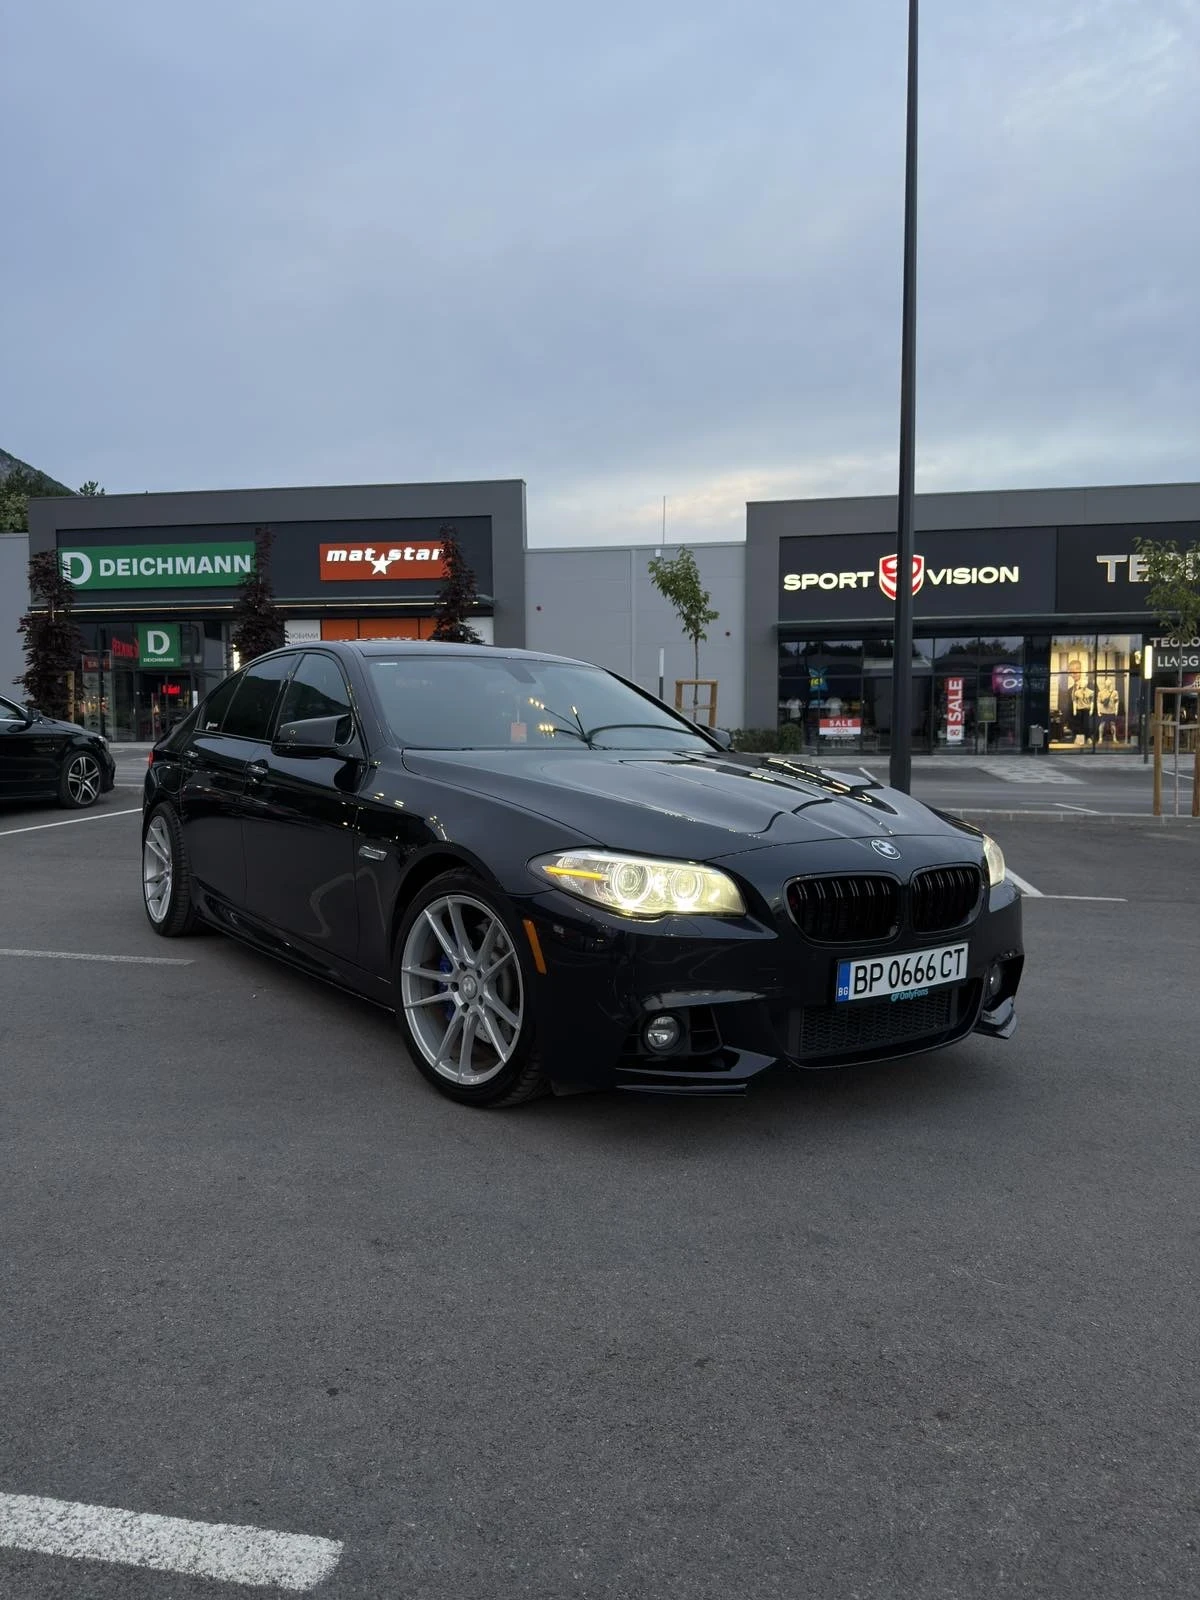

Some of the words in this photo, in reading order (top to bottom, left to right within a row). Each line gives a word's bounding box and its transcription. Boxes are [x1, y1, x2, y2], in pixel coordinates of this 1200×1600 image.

[99, 554, 251, 577] DEICHMANN
[326, 547, 376, 562] mat
[388, 546, 445, 561] star
[783, 570, 875, 591] SPORT
[926, 566, 1019, 586] VISION
[948, 679, 963, 721] SALE
[838, 986, 849, 997] BG
